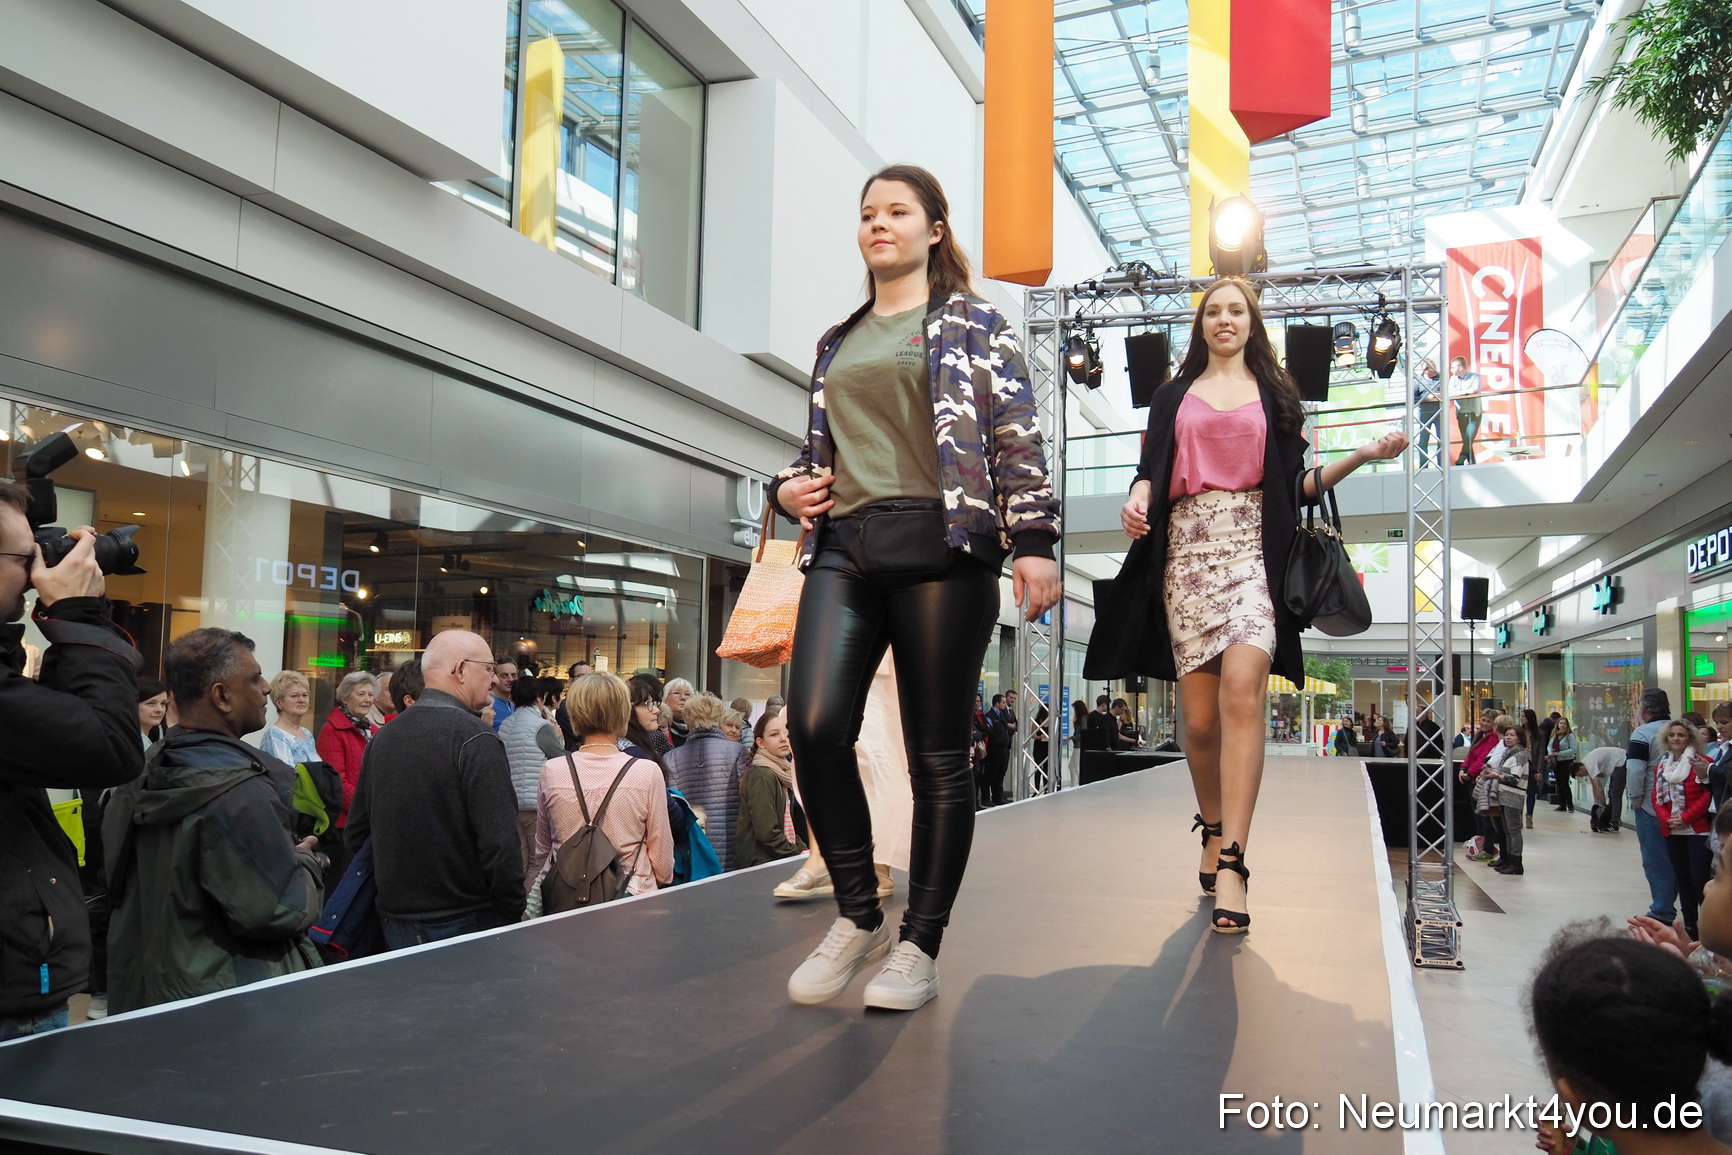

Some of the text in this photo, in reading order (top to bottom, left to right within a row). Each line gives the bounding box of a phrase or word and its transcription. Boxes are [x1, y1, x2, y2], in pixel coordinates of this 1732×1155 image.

[896, 351, 924, 359] LEAGUE
[1471, 265, 1516, 463] CINEPLEX
[1687, 526, 1732, 574] DEPO
[374, 631, 402, 644] U-EINS
